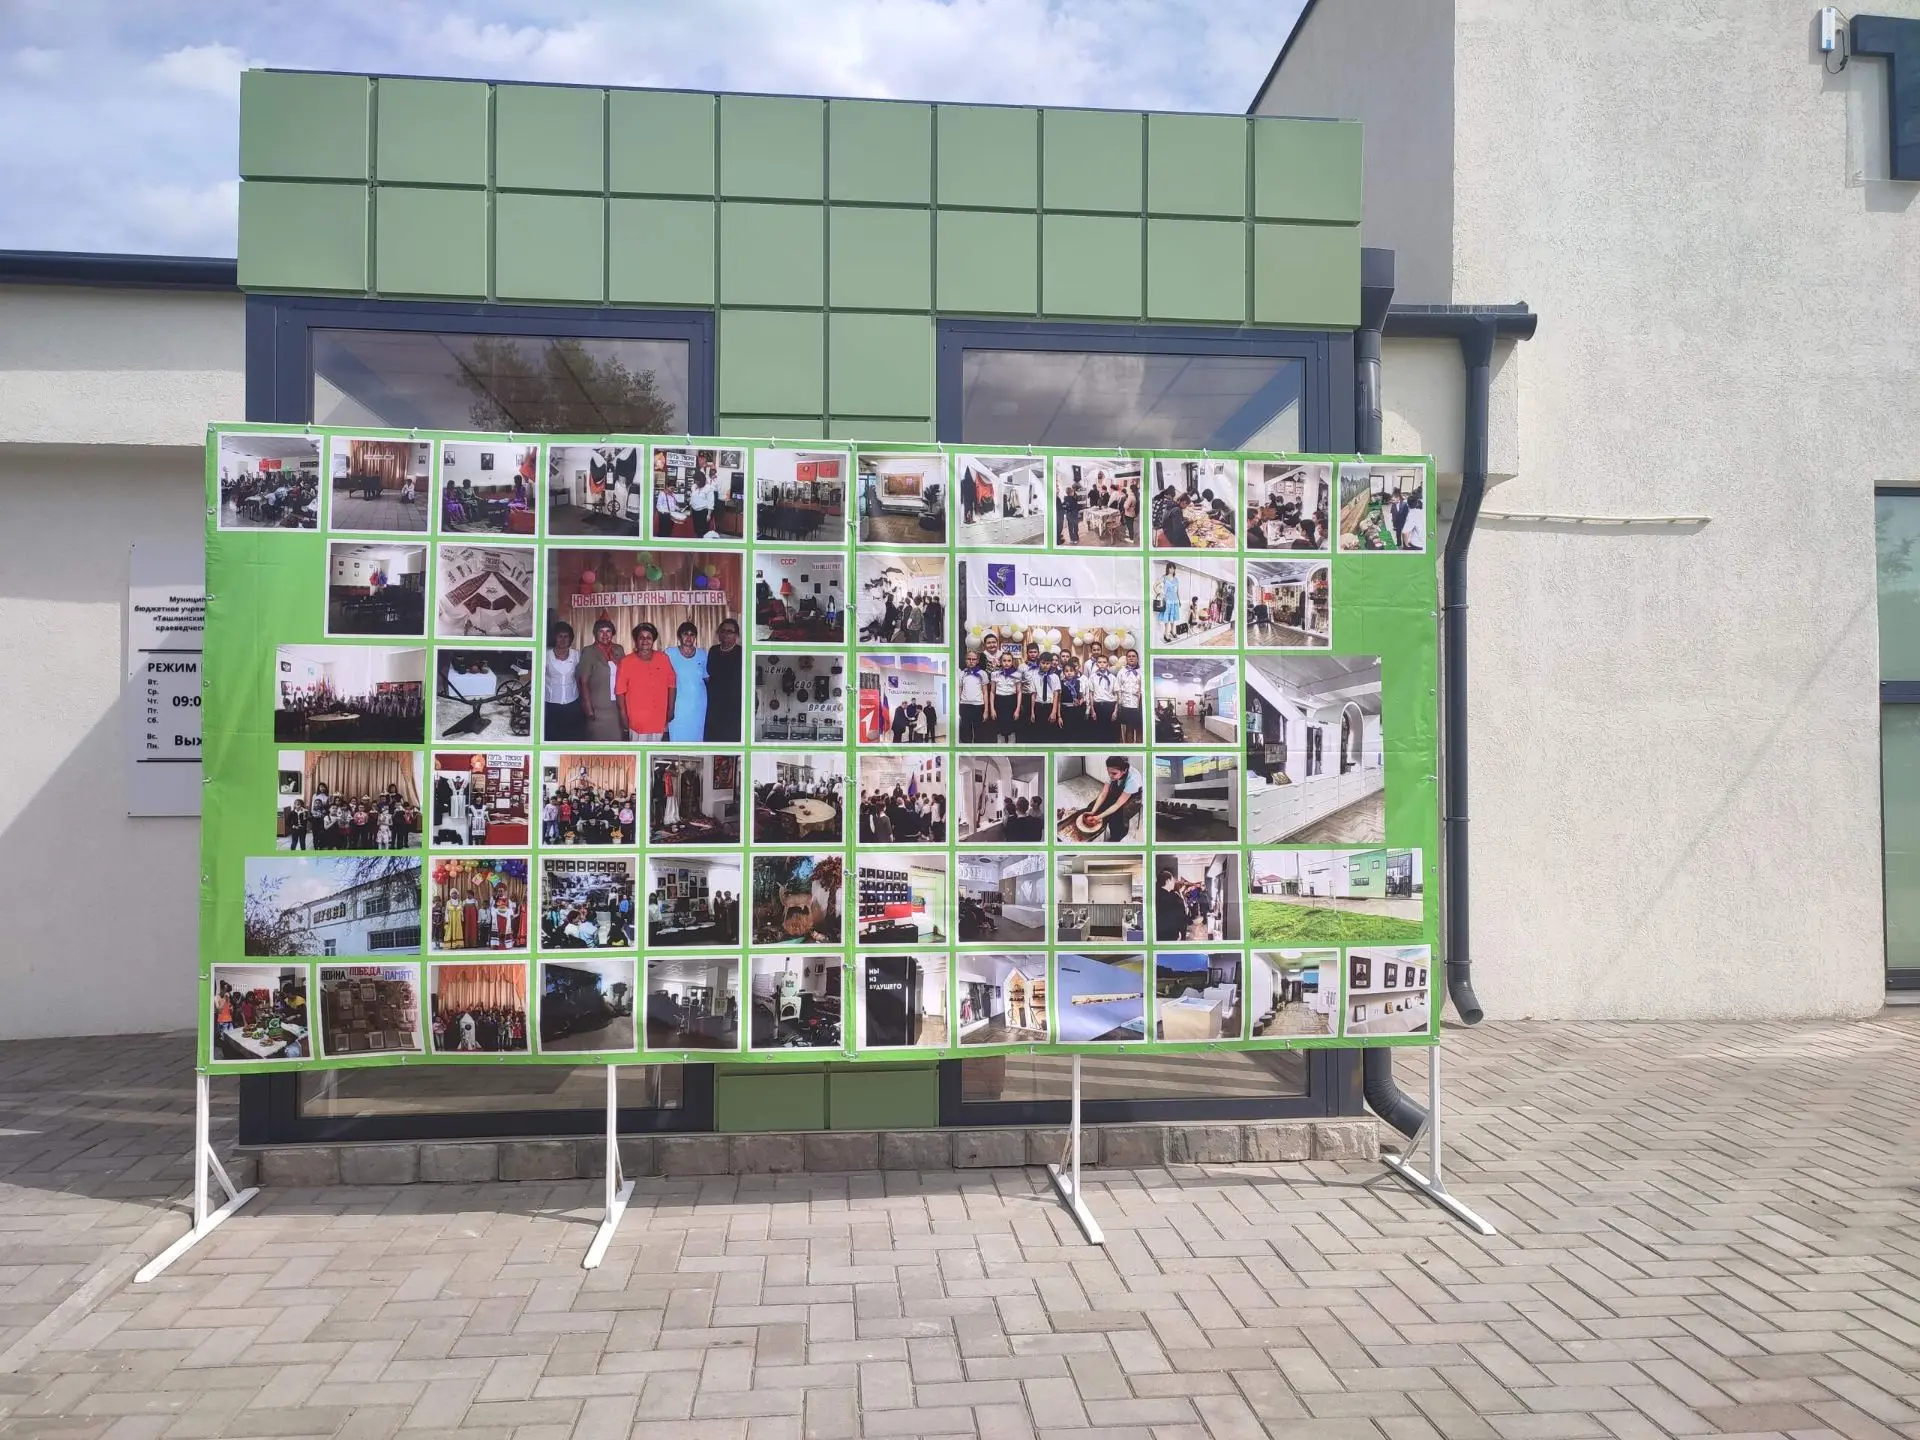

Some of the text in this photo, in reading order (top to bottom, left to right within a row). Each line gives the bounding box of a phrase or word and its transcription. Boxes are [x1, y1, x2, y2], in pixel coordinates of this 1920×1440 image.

[780, 558, 797, 566] СССР
[1021, 572, 1072, 587] Ташла
[572, 591, 725, 607] ЮБИЛЕЙ СТРАНЫ ДЕТСТВА
[134, 604, 179, 613] бюджетное
[987, 599, 1141, 617] Ташлинский район
[147, 662, 197, 673] РЕЖИМ
[147, 688, 160, 696] Ср.
[147, 697, 159, 705] Чт.
[172, 695, 202, 708] 09:0
[147, 707, 159, 715] Пт.
[147, 716, 160, 724] Сб.
[174, 734, 203, 747] Вых
